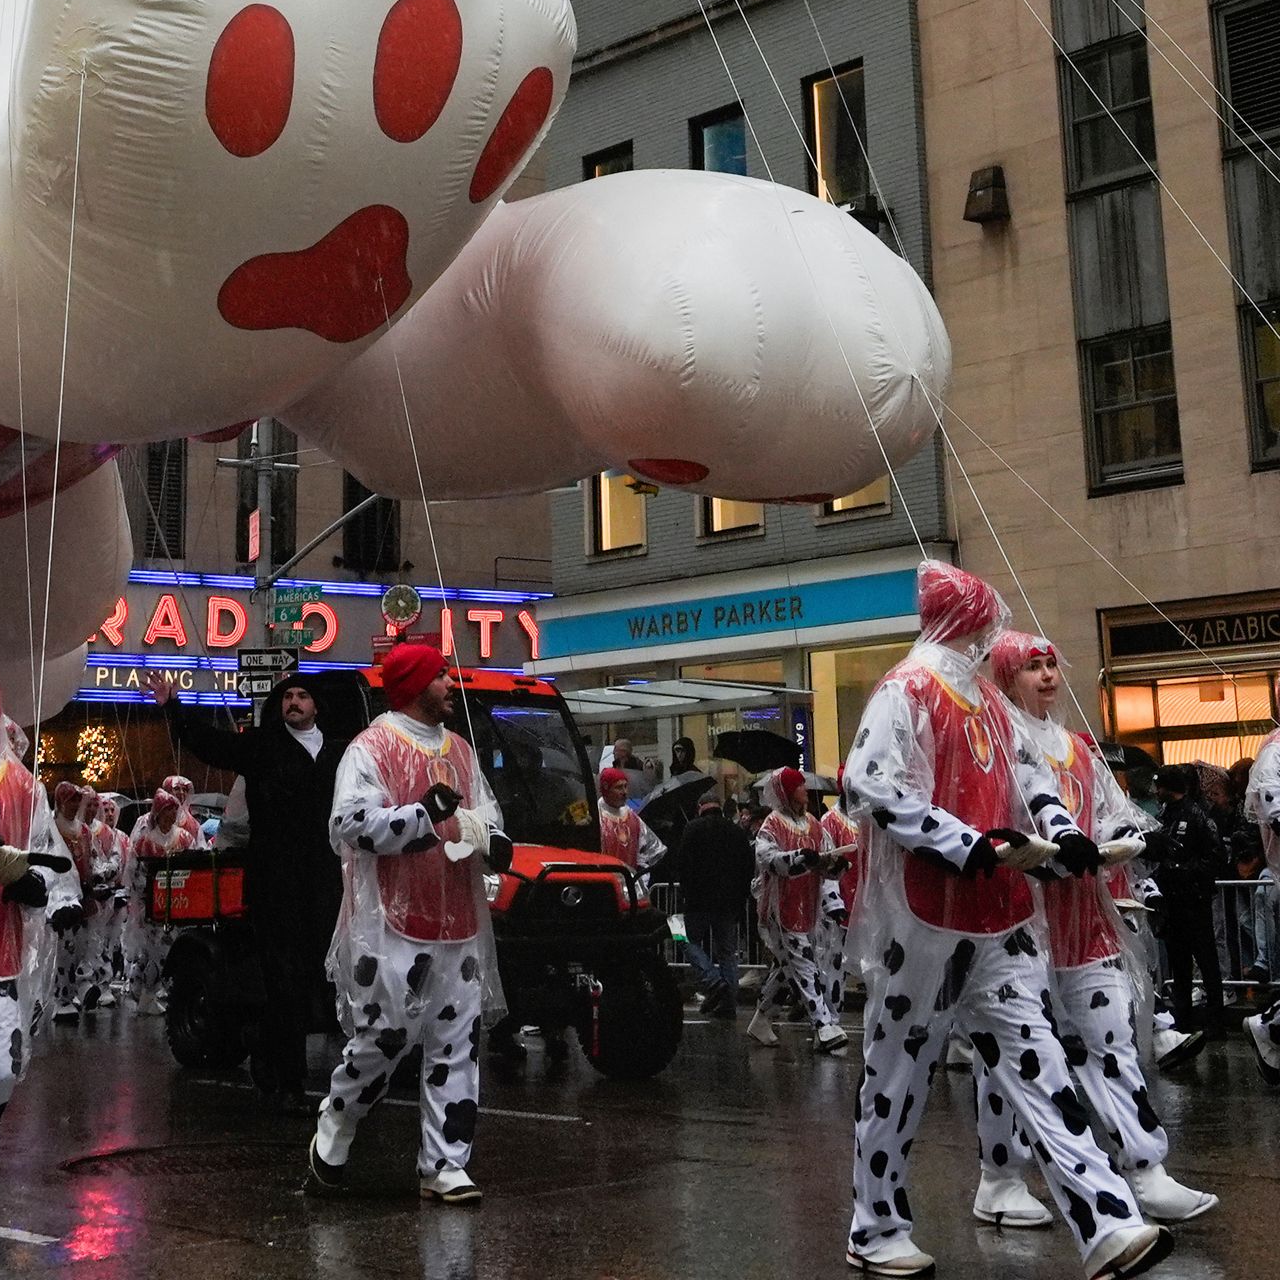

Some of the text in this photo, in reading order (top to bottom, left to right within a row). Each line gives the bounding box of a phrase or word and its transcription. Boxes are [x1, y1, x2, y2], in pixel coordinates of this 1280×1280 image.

[277, 592, 320, 604] AMERICAS
[280, 608, 288, 621] 6
[627, 596, 805, 640] WARBY PARKER
[87, 594, 540, 660] RADO ITY
[290, 630, 303, 645] 50
[246, 655, 290, 665] ONE WAY
[96, 666, 237, 691] PLANG TH
[257, 681, 269, 692] WAY
